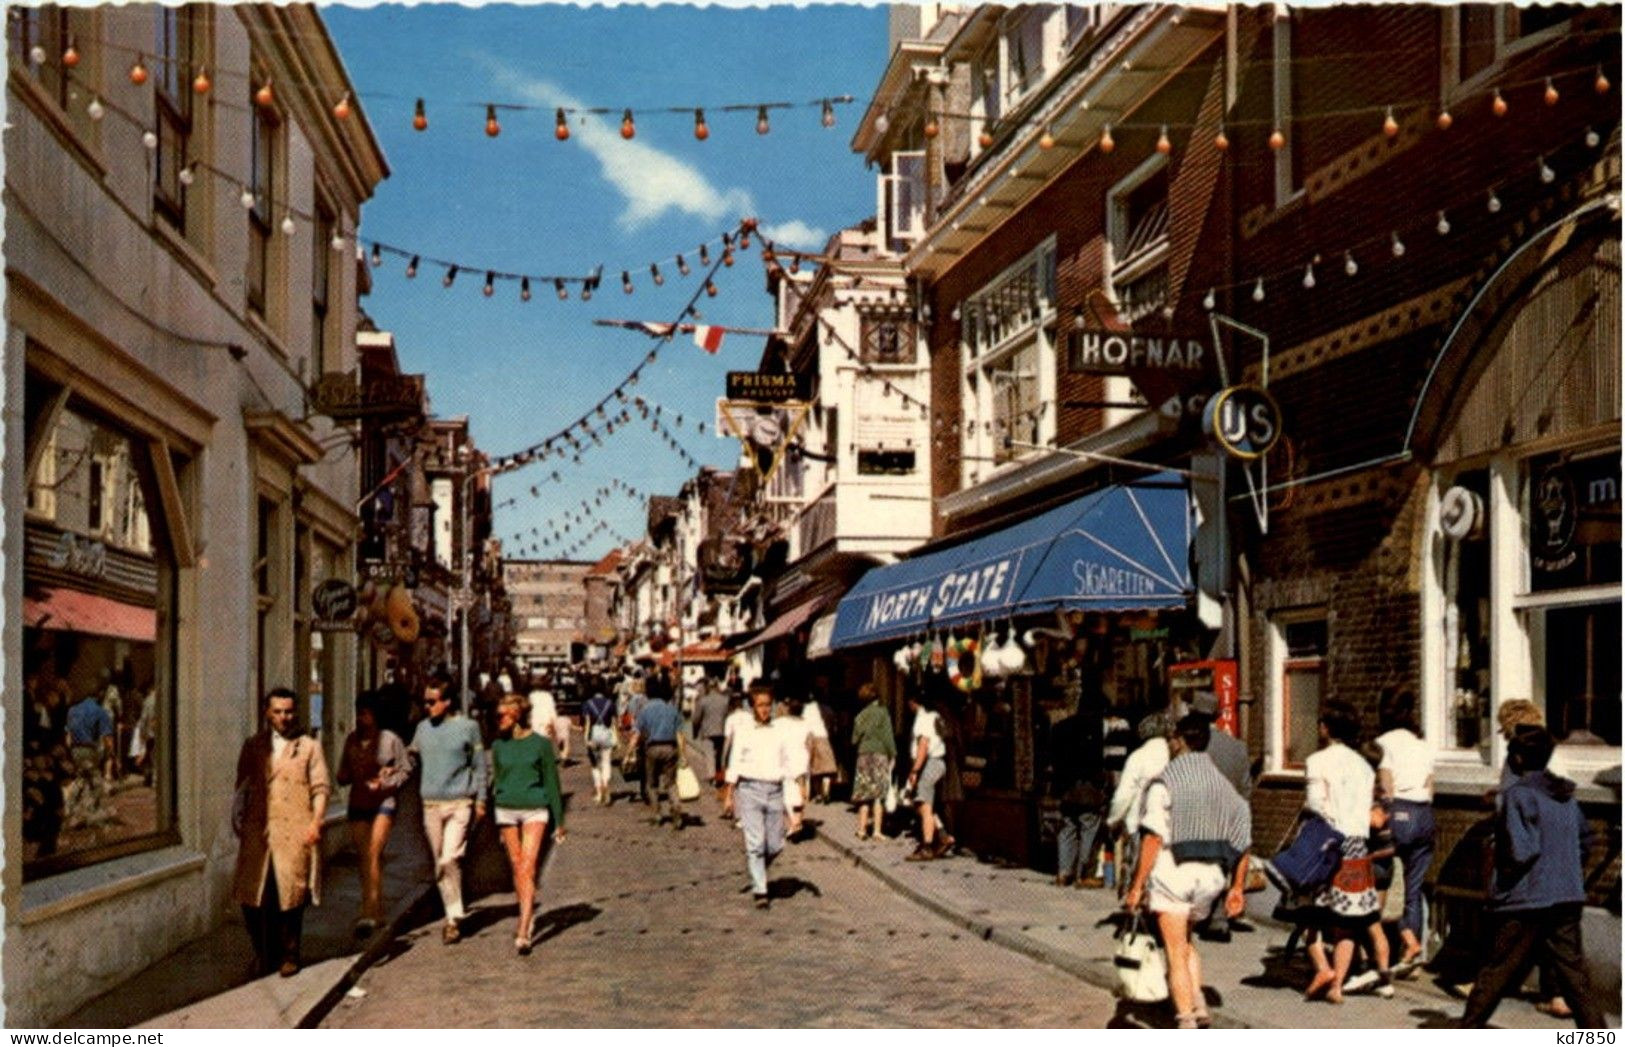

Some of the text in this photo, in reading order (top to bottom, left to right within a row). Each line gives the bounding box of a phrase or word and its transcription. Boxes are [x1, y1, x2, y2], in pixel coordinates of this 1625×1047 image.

[1082, 333, 1204, 369] HOFNAR
[1072, 558, 1155, 595] SIGARETTEN
[864, 560, 1010, 632] NORTH STATE
